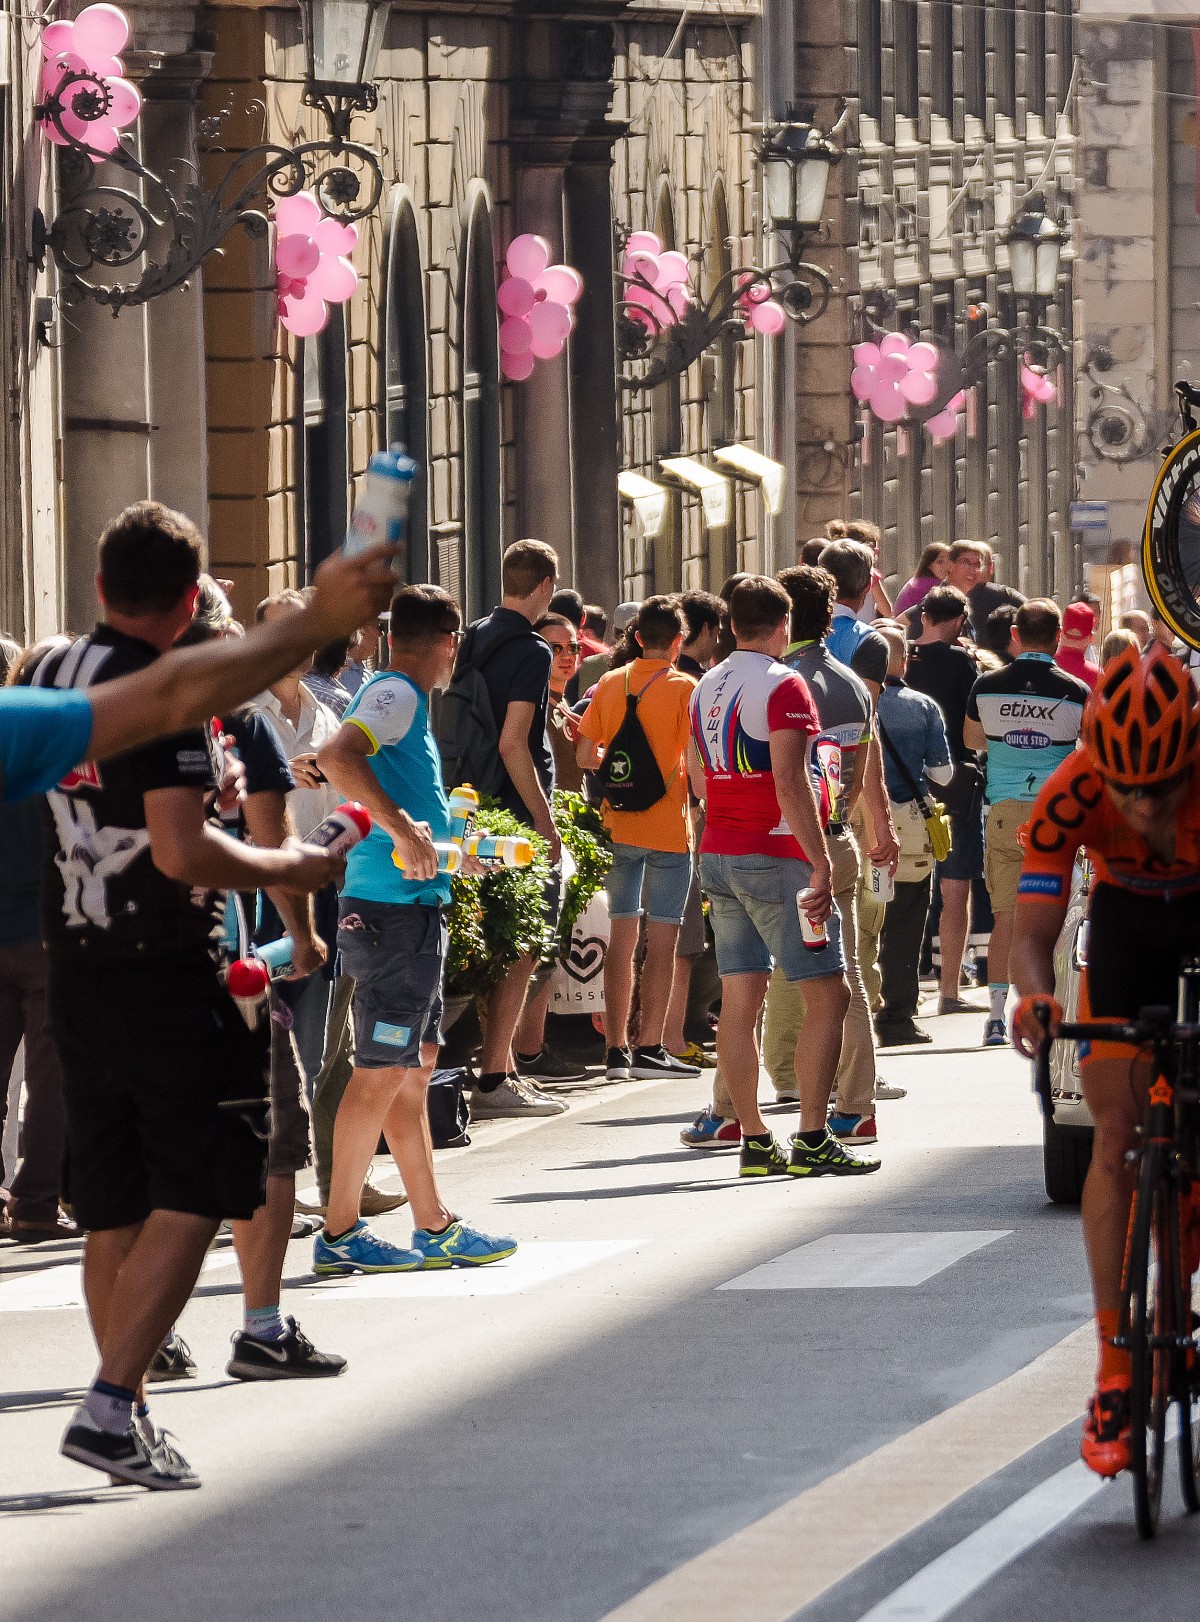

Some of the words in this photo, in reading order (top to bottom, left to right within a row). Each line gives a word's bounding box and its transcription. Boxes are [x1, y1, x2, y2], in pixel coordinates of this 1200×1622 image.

[706, 669, 734, 744] КАТЮША
[1000, 700, 1046, 719] etixx
[1006, 734, 1029, 745] QUICK
[1031, 735, 1049, 746] STEP
[1031, 772, 1101, 853] CCC
